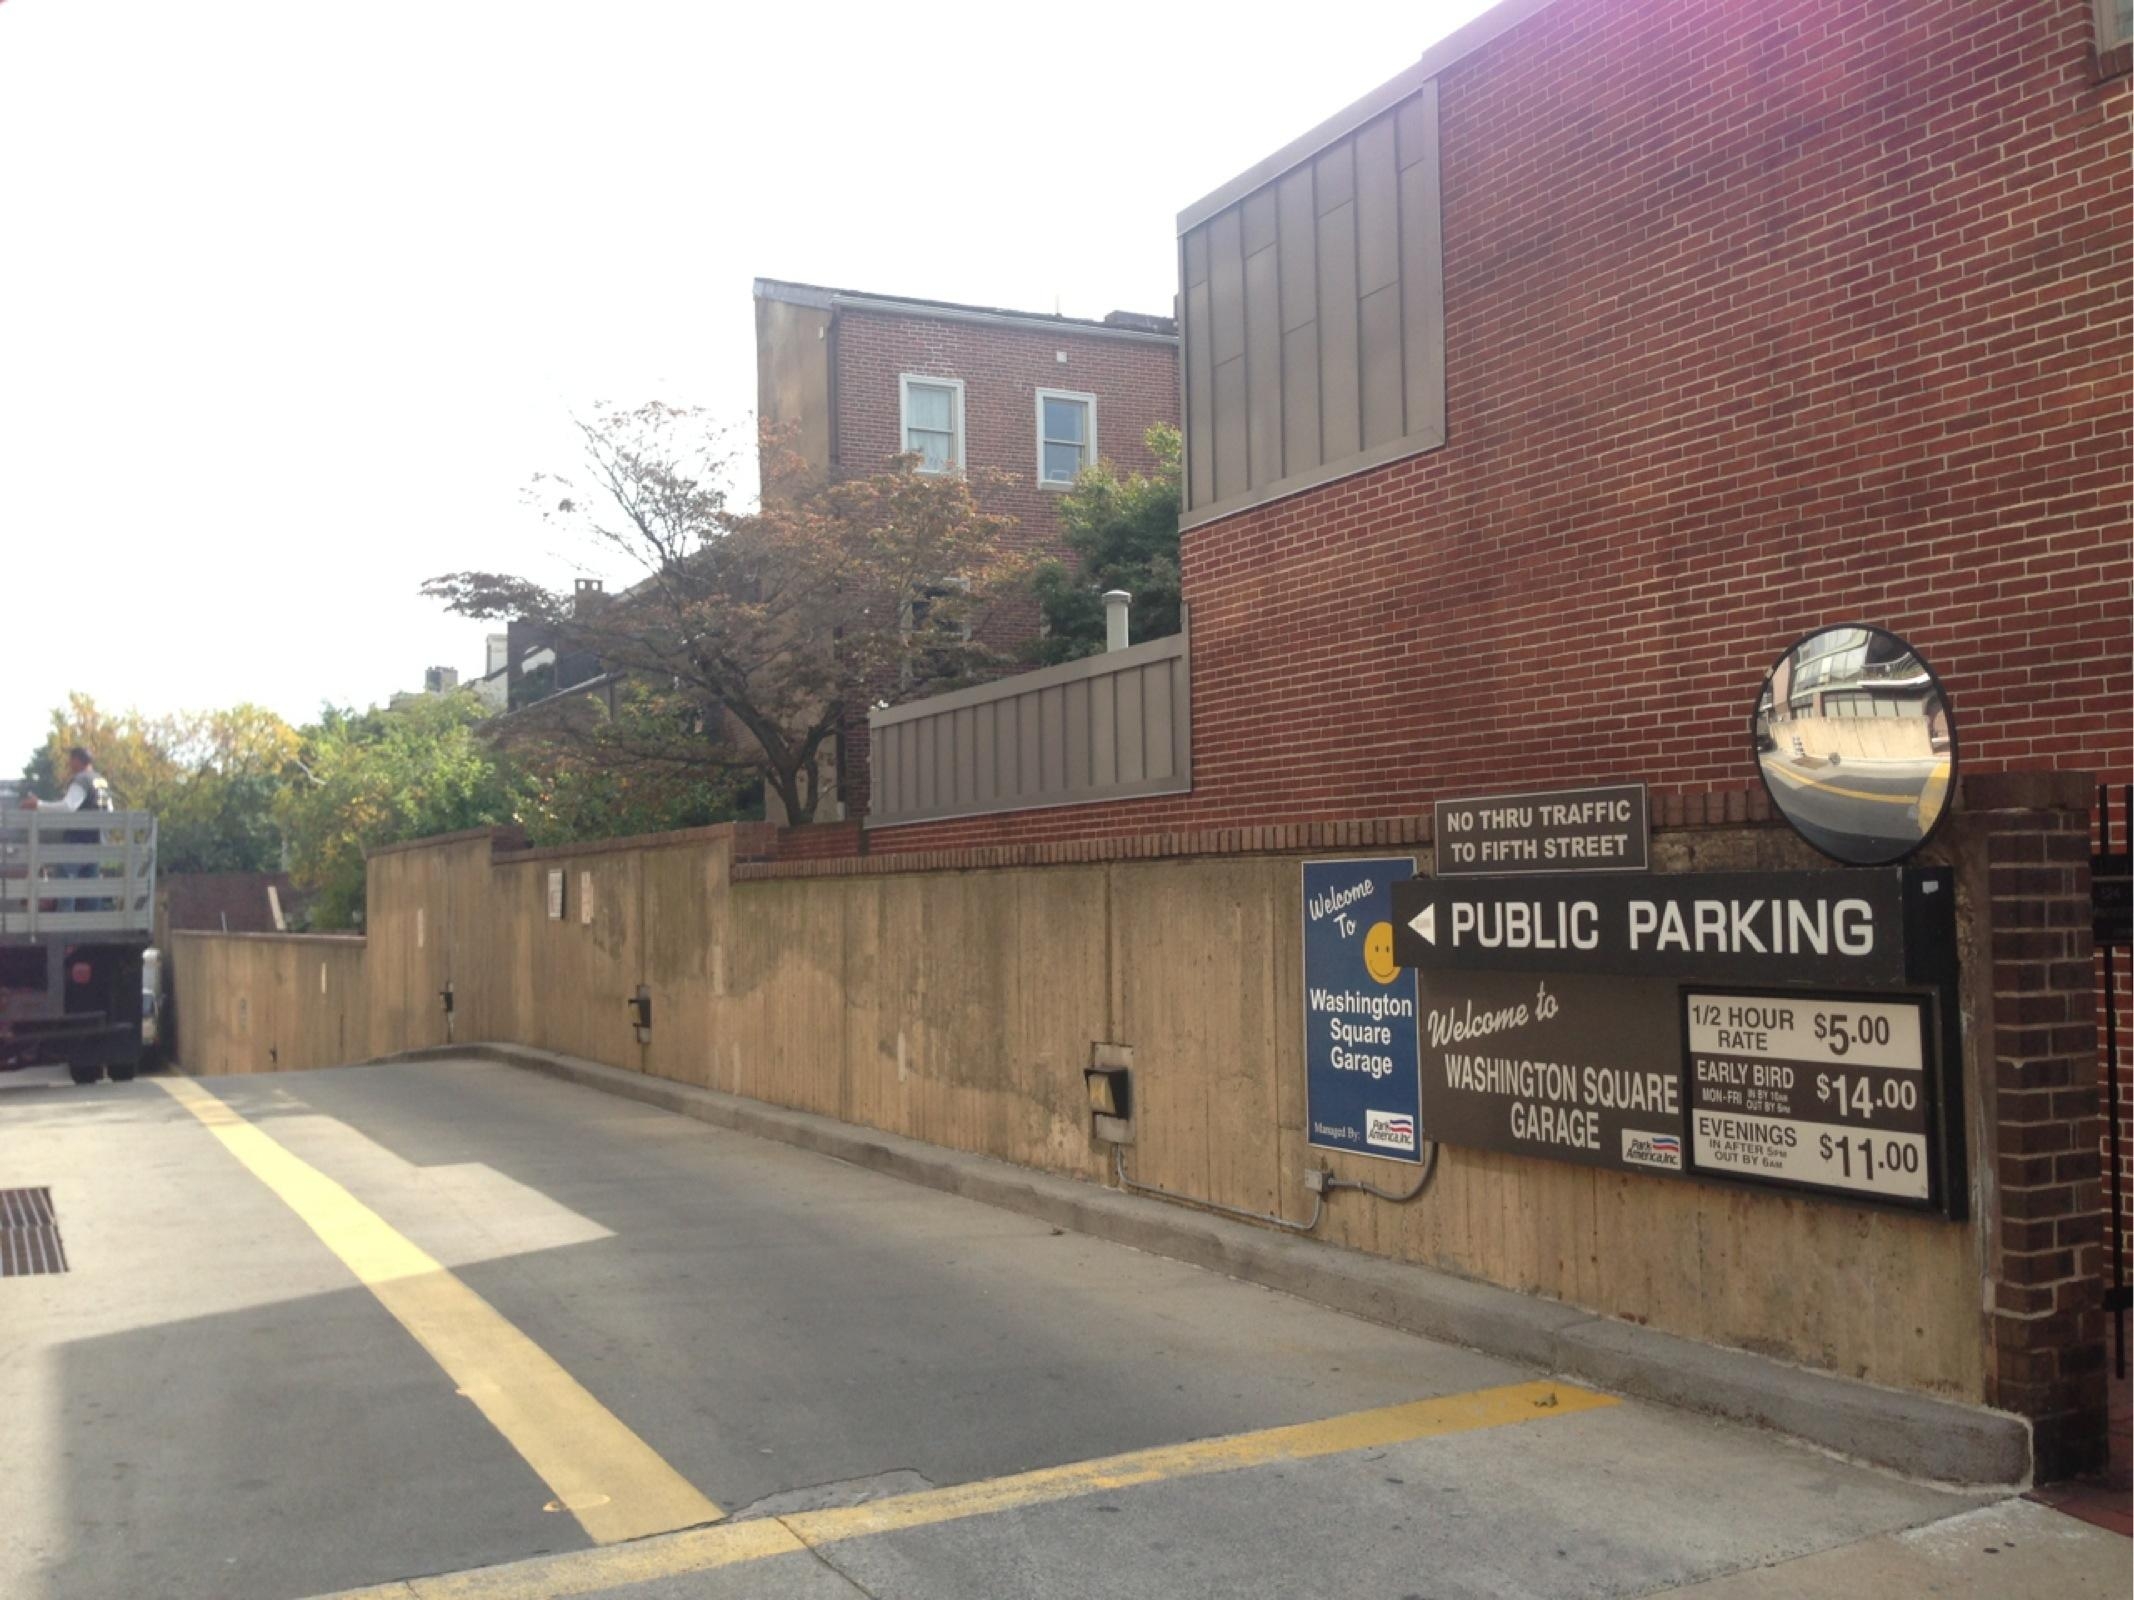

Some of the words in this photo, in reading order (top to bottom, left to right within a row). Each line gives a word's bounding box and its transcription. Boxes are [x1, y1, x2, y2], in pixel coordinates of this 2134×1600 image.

[1447, 811, 1473, 832] NO
[1479, 807, 1533, 830] THRU
[1539, 799, 1631, 826] TRAFFIC
[1450, 842, 1476, 863] TO
[1481, 838, 1537, 861] FIFTH
[1544, 834, 1628, 859] STREET
[1309, 877, 1375, 921] Welcome
[1334, 912, 1357, 939] To
[1450, 899, 1599, 951] PUBLIC
[1628, 897, 1875, 956] PARKING
[1310, 987, 1413, 1021] Washington
[1427, 998, 1529, 1048] Welcome
[1535, 980, 1560, 1022] to
[1692, 1004, 1721, 1027] 1/2
[1728, 1007, 1794, 1031] HOUR
[1330, 1018, 1392, 1048] Square
[1717, 1029, 1768, 1051] RATE
[1814, 1012, 1890, 1056] $5.00
[1330, 1046, 1393, 1079] Garage
[1697, 1059, 1750, 1086] EARLY
[1753, 1066, 1794, 1089] BIRD
[1445, 1053, 1579, 1101] WASHINGTON
[1582, 1067, 1680, 1114] SQUARE
[1702, 1087, 1743, 1105] MON-FRI
[1816, 1072, 1917, 1119] $14.00
[1746, 1100, 1763, 1111] OUT
[1314, 1121, 1346, 1139] Managed
[1372, 1119, 1391, 1132] Park
[1510, 1101, 1601, 1150] GARAGE
[1699, 1116, 1798, 1148] EVENINGS
[1632, 1137, 1652, 1150] Park
[1709, 1139, 1721, 1149] IN
[1724, 1141, 1764, 1154] AFTER
[1714, 1151, 1738, 1162] OUT
[1743, 1154, 1759, 1165] BY
[1819, 1132, 1919, 1180] $11.00
